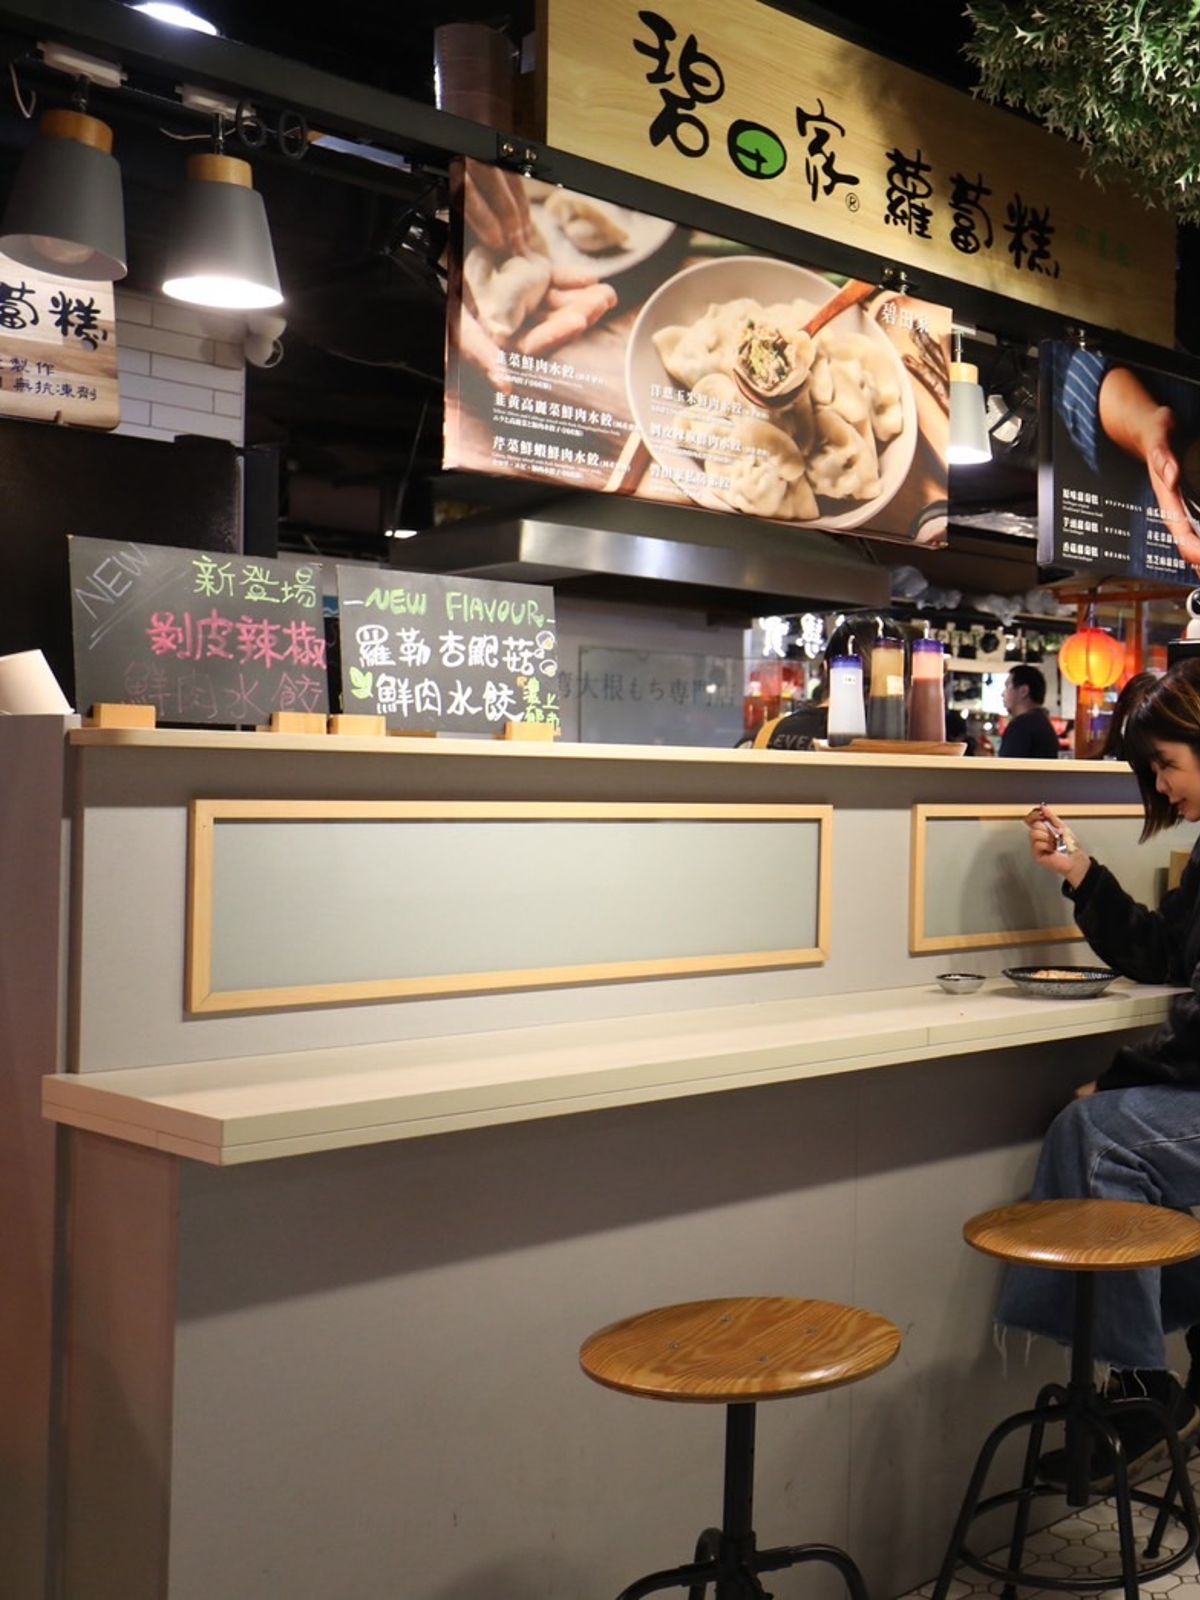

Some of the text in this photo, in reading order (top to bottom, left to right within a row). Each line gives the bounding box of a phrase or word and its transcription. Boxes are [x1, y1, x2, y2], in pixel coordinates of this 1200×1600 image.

[74, 542, 150, 620] NEW
[192, 555, 317, 608] 新登場
[365, 587, 428, 616] NEW
[356, 624, 535, 676] 羅勒杏鮑菇
[121, 660, 324, 719] 鮮肉水餃
[376, 672, 525, 723] 鮮肉水餃
